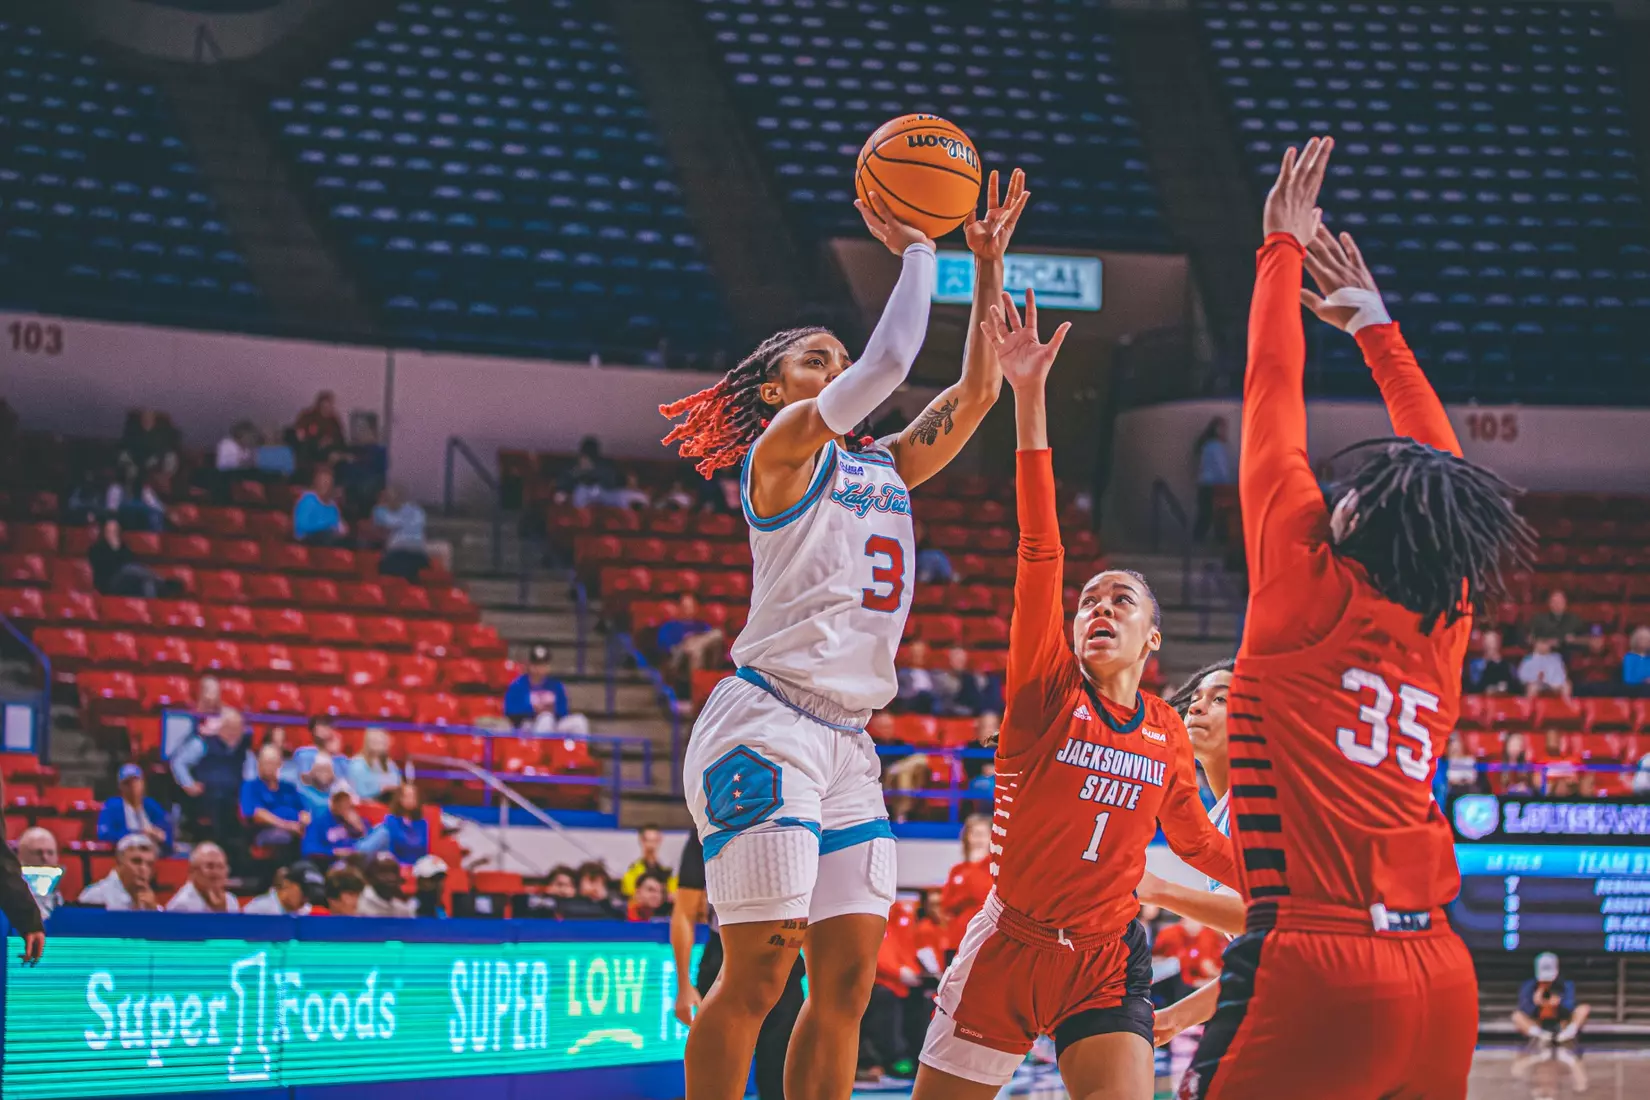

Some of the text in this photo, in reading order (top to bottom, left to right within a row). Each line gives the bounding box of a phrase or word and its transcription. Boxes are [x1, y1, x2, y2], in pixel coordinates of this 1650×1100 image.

[906, 134, 979, 170] Wilson
[8, 320, 63, 356] 103
[1464, 412, 1519, 443] 105
[830, 477, 913, 519] Lady Tec
[861, 533, 906, 614] 3
[1336, 666, 1439, 782] 35
[1055, 737, 1168, 787] JACKSONVILLE
[1078, 774, 1143, 811] STATE
[1081, 811, 1111, 863] 1
[1578, 851, 1629, 873] TEAM
[84, 970, 228, 1068] Super
[271, 965, 396, 1042] Foods
[450, 959, 548, 1053] SUPER
[567, 957, 648, 1017] LOW
